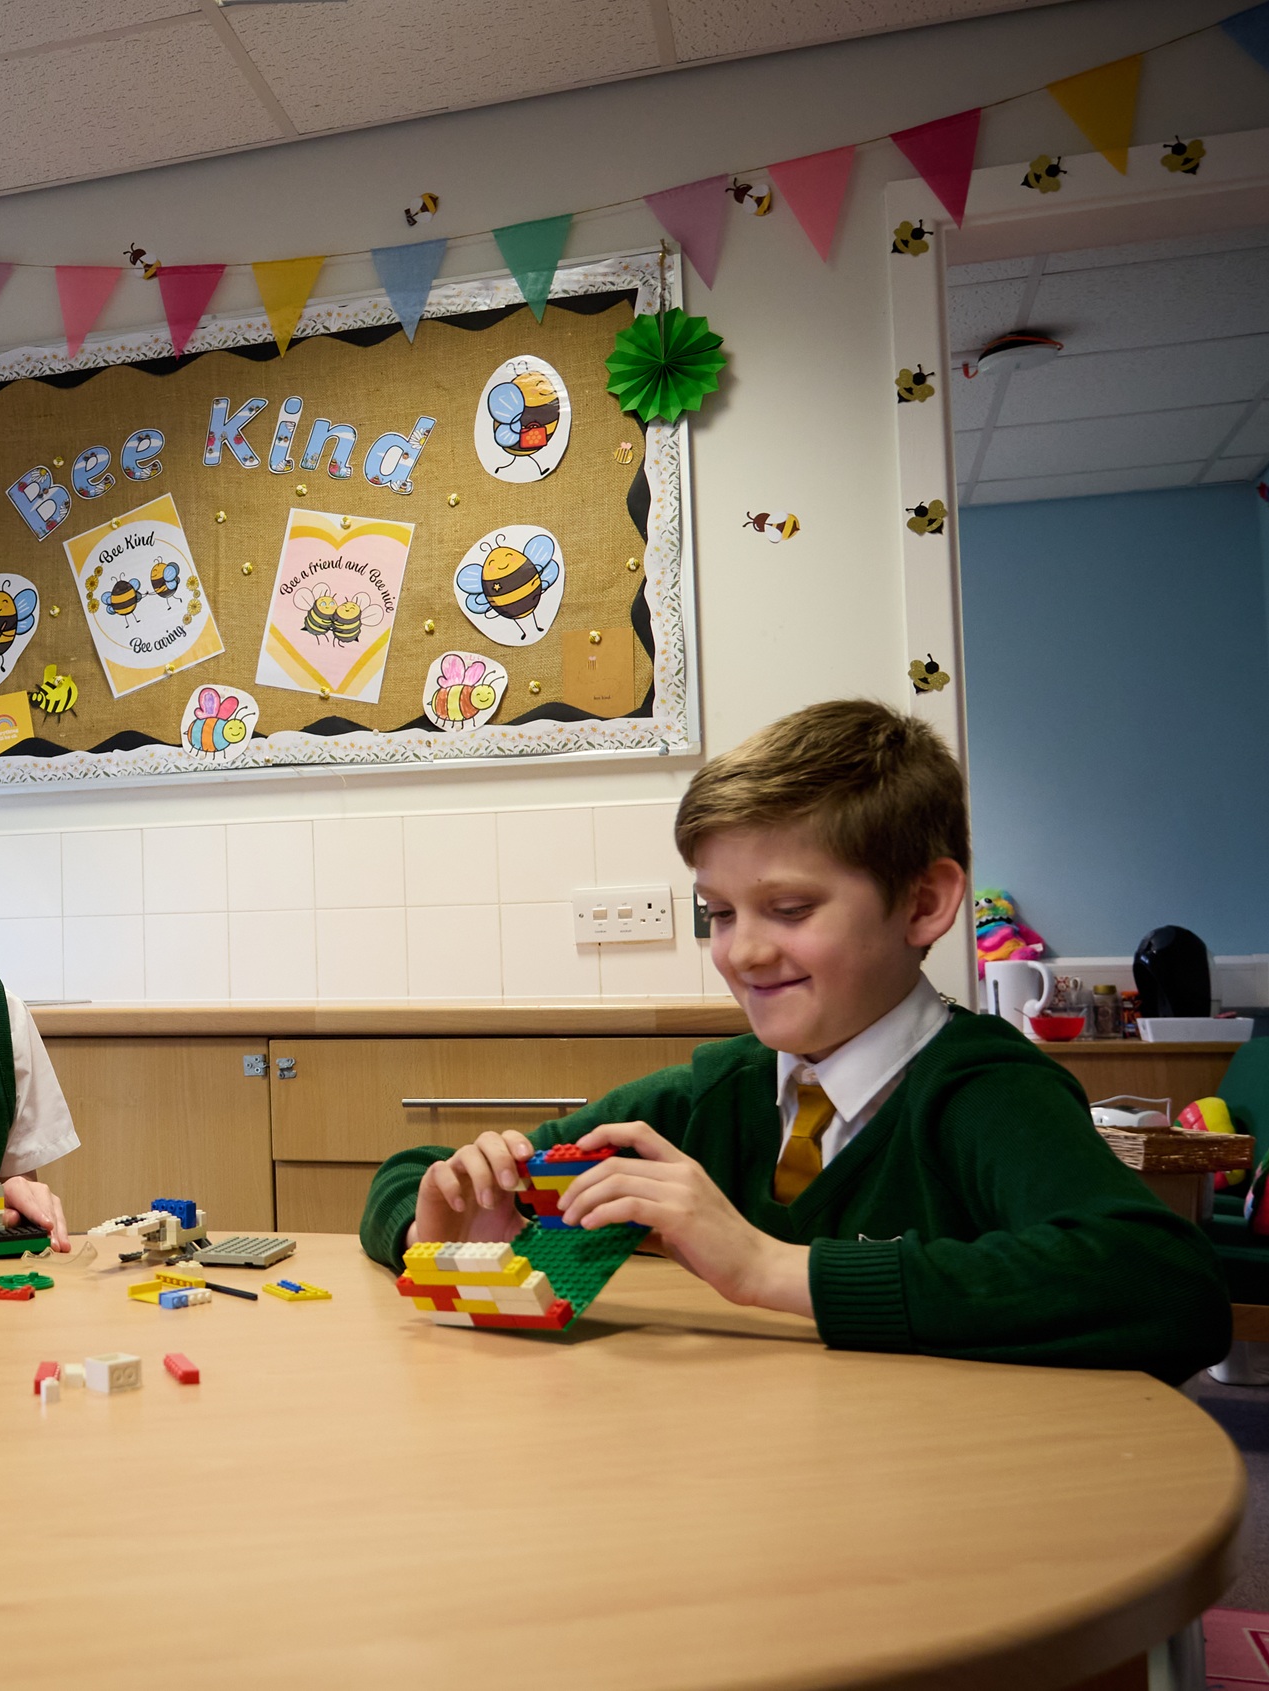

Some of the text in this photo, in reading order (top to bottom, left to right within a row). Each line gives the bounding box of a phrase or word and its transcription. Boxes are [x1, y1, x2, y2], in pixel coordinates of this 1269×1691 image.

[6, 396, 438, 541] Bee Kind
[98, 530, 156, 565] Bee Kind
[279, 556, 396, 614] Bee a friend and Bee nice
[129, 625, 187, 654] Bee caring
